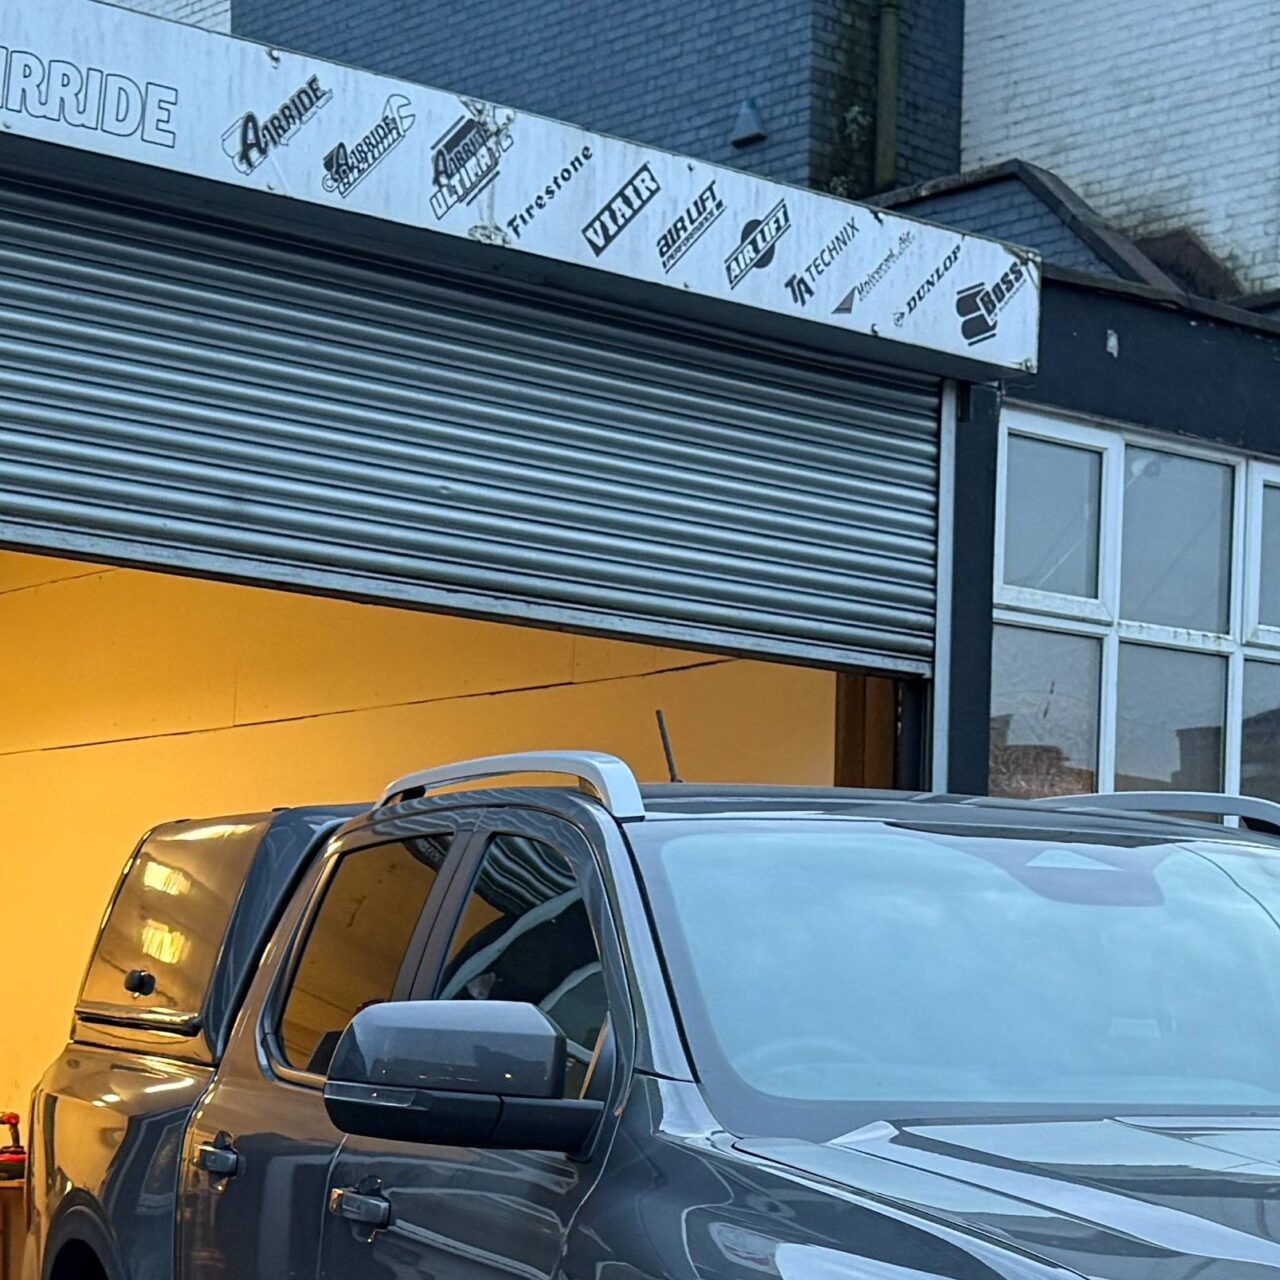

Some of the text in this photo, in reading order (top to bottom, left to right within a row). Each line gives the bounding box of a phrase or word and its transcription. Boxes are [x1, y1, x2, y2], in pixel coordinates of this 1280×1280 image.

[239, 74, 328, 169] AIRRIDE
[507, 145, 593, 240] Firestone
[583, 168, 659, 250] VIAIR
[729, 205, 788, 281] AIR LIFT
[804, 216, 860, 282] TECHNIX
[906, 244, 961, 315] DUNLOP
